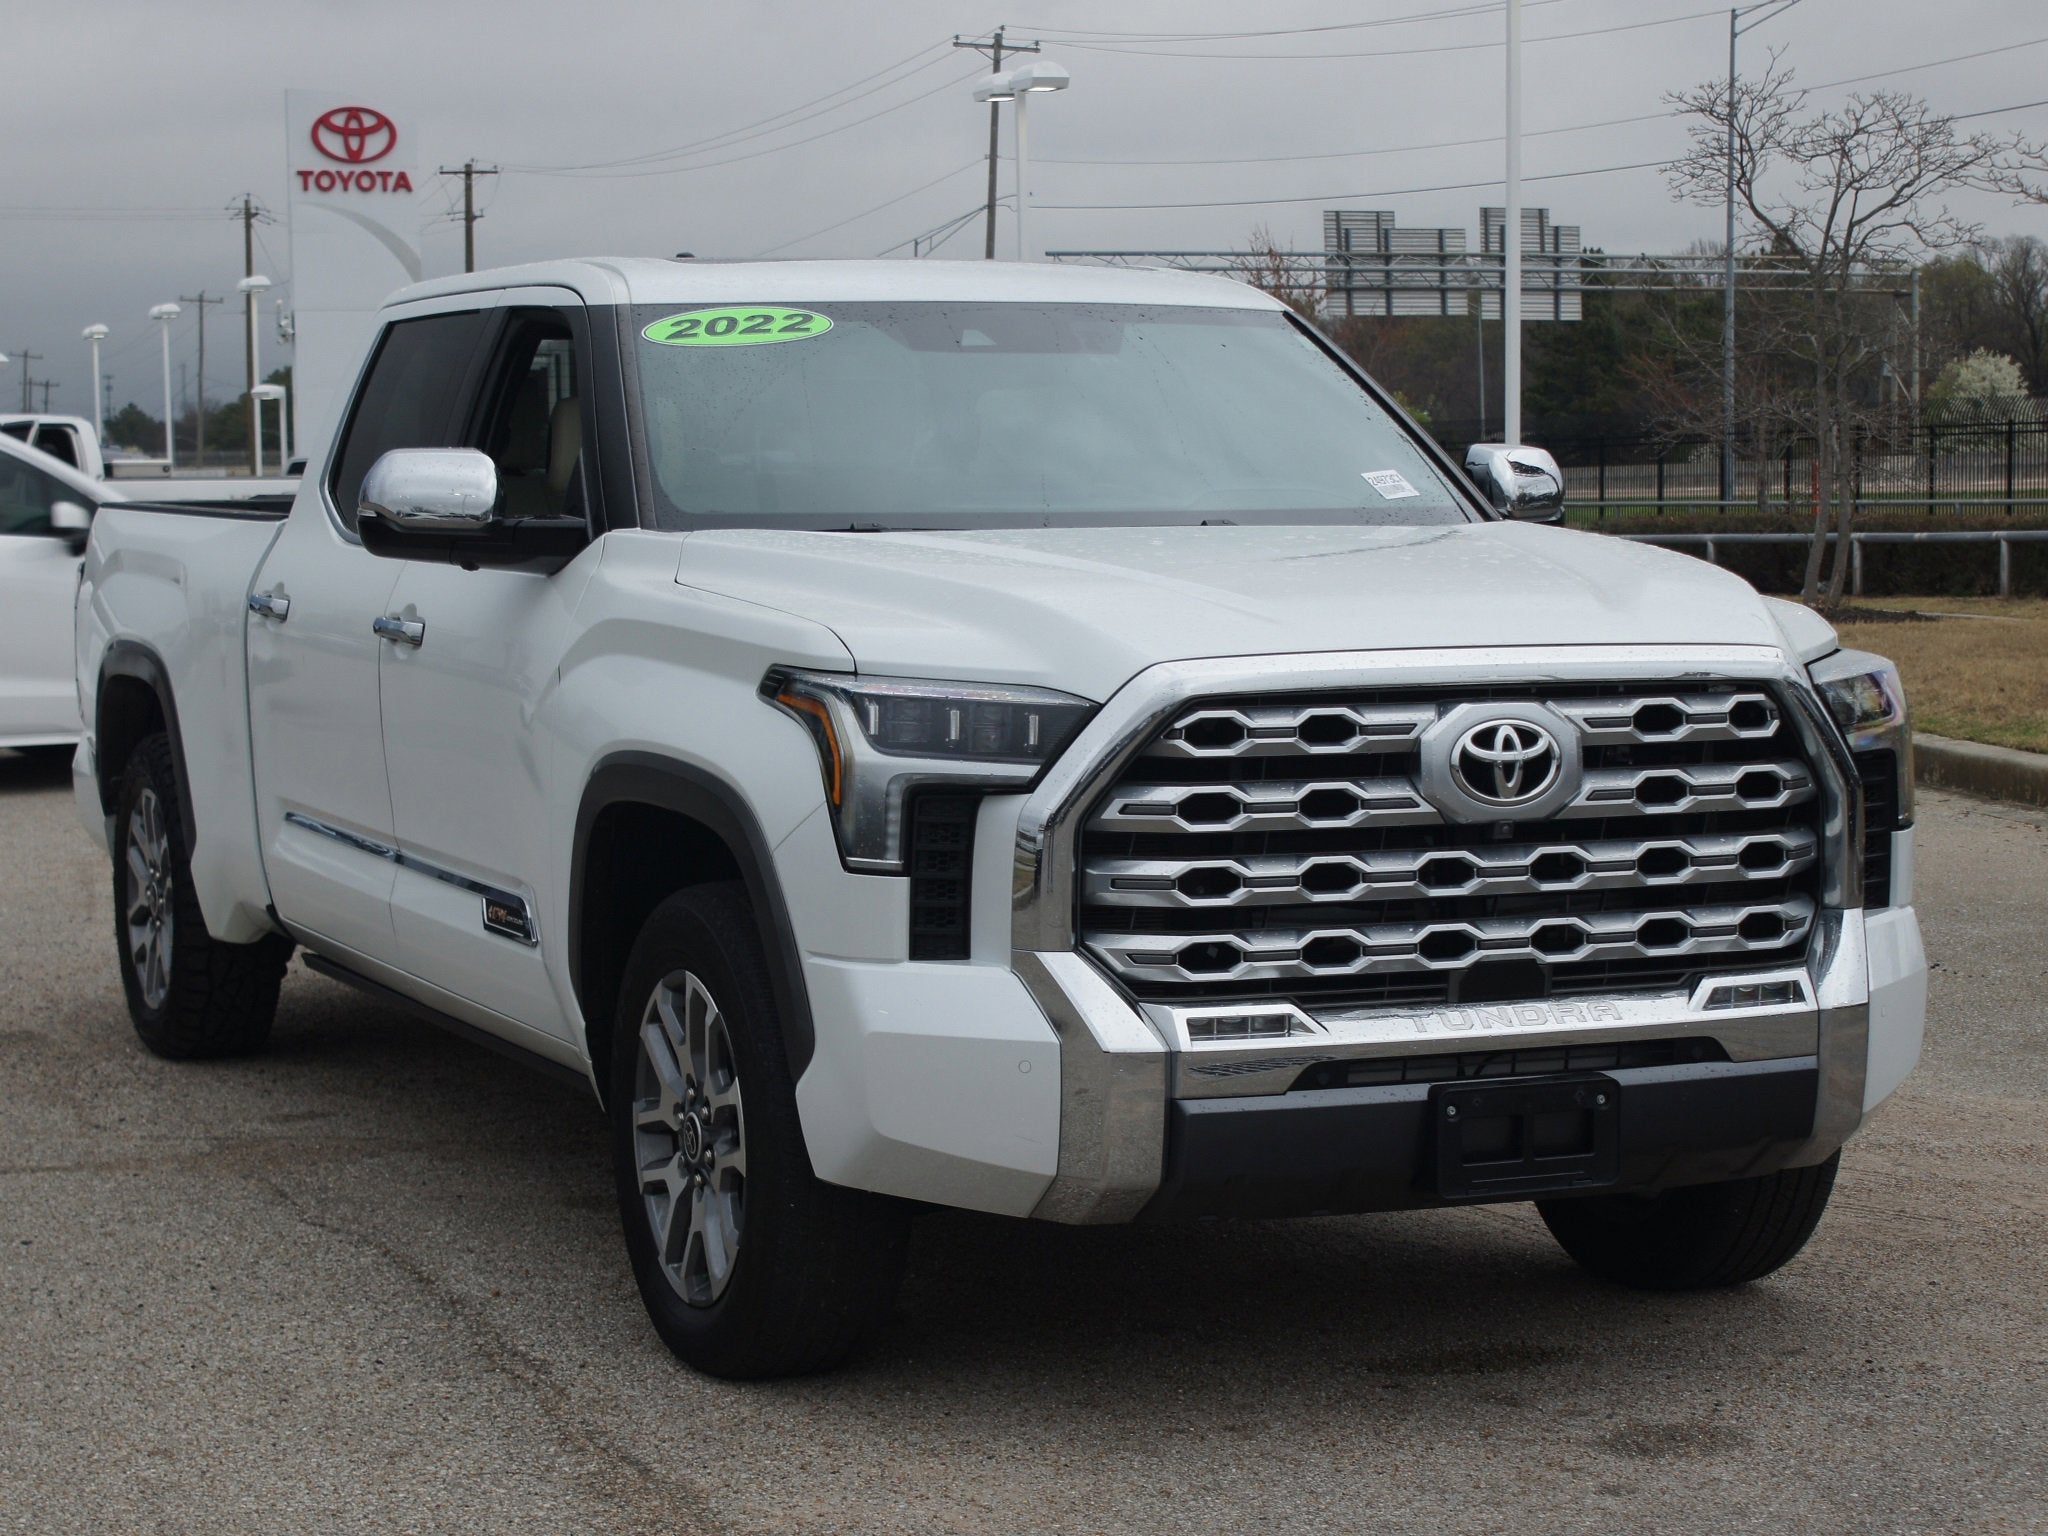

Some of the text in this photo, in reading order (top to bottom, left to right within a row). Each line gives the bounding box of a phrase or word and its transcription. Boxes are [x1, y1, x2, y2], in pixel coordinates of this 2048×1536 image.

[296, 170, 413, 192] TOYOTA
[665, 313, 815, 340] 2022
[1402, 1000, 1623, 1033] TUNDRA
